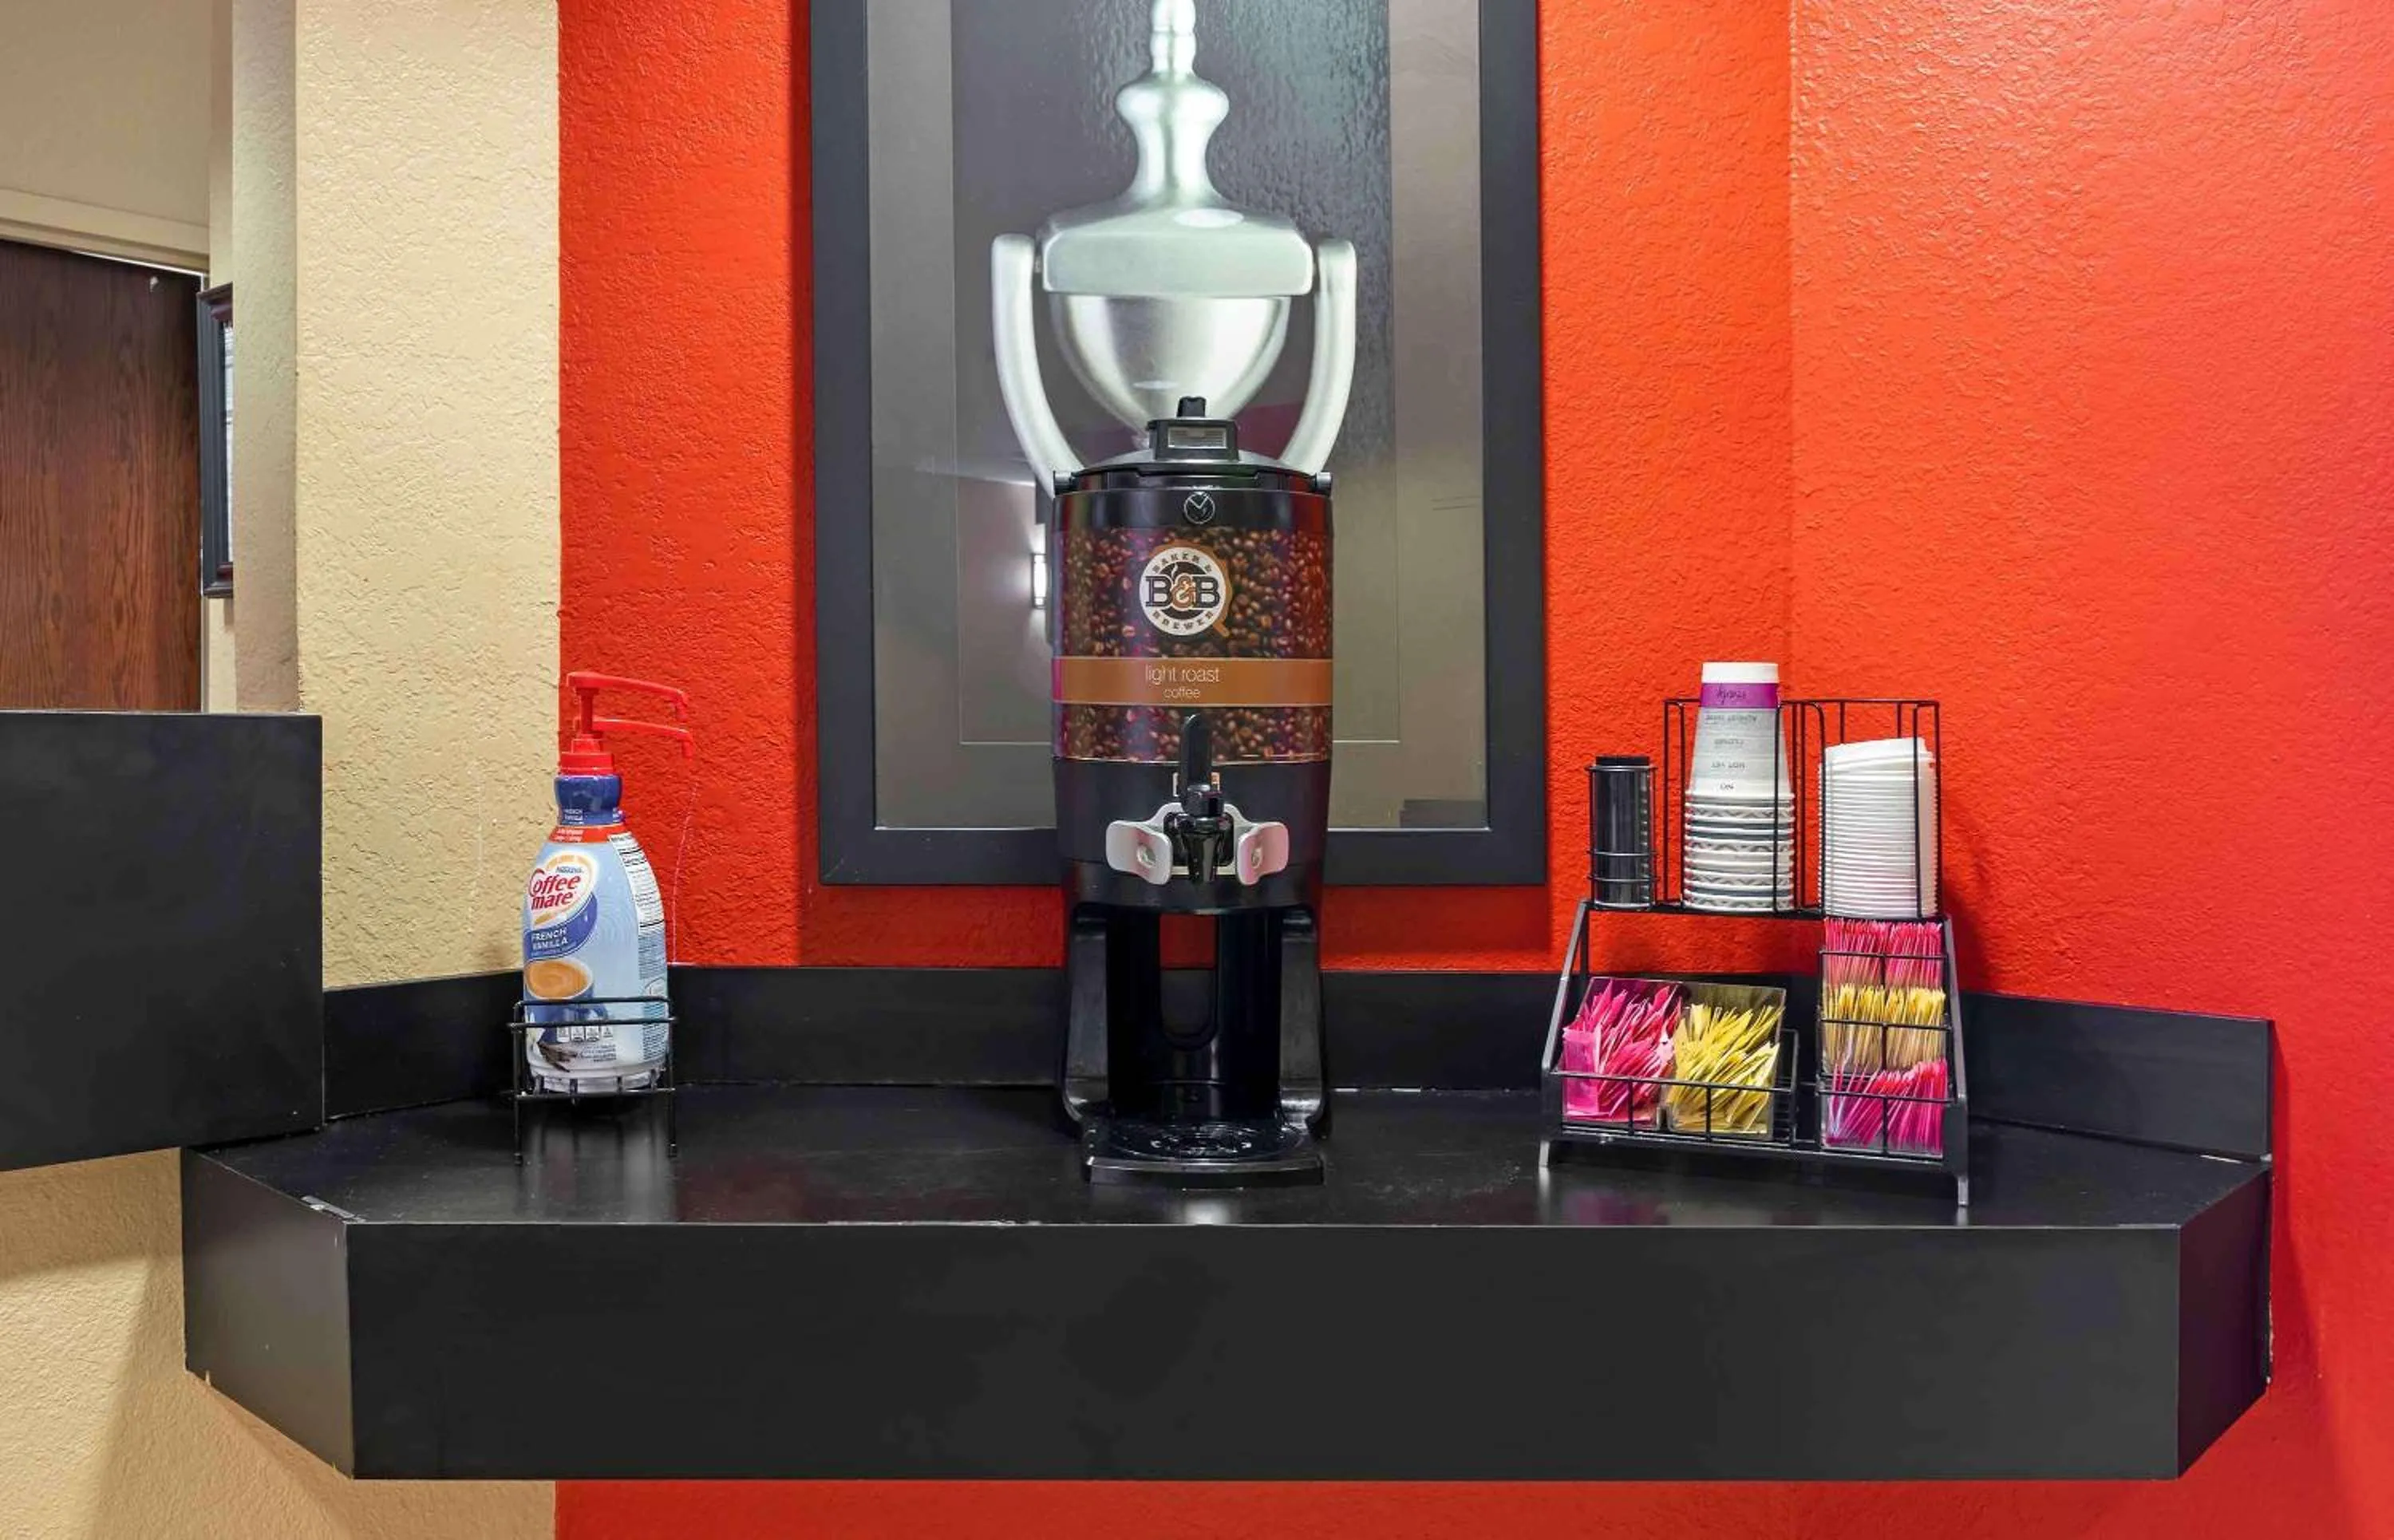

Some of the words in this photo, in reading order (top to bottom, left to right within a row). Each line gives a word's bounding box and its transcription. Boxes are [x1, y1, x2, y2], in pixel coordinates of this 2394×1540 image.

[1145, 575, 1221, 608] B&B
[1145, 663, 1177, 685] light
[1182, 667, 1220, 683] roast
[1163, 687, 1201, 699] coffee
[529, 867, 582, 898] Coffee
[531, 891, 574, 910] mate
[531, 927, 567, 942] FRENCH
